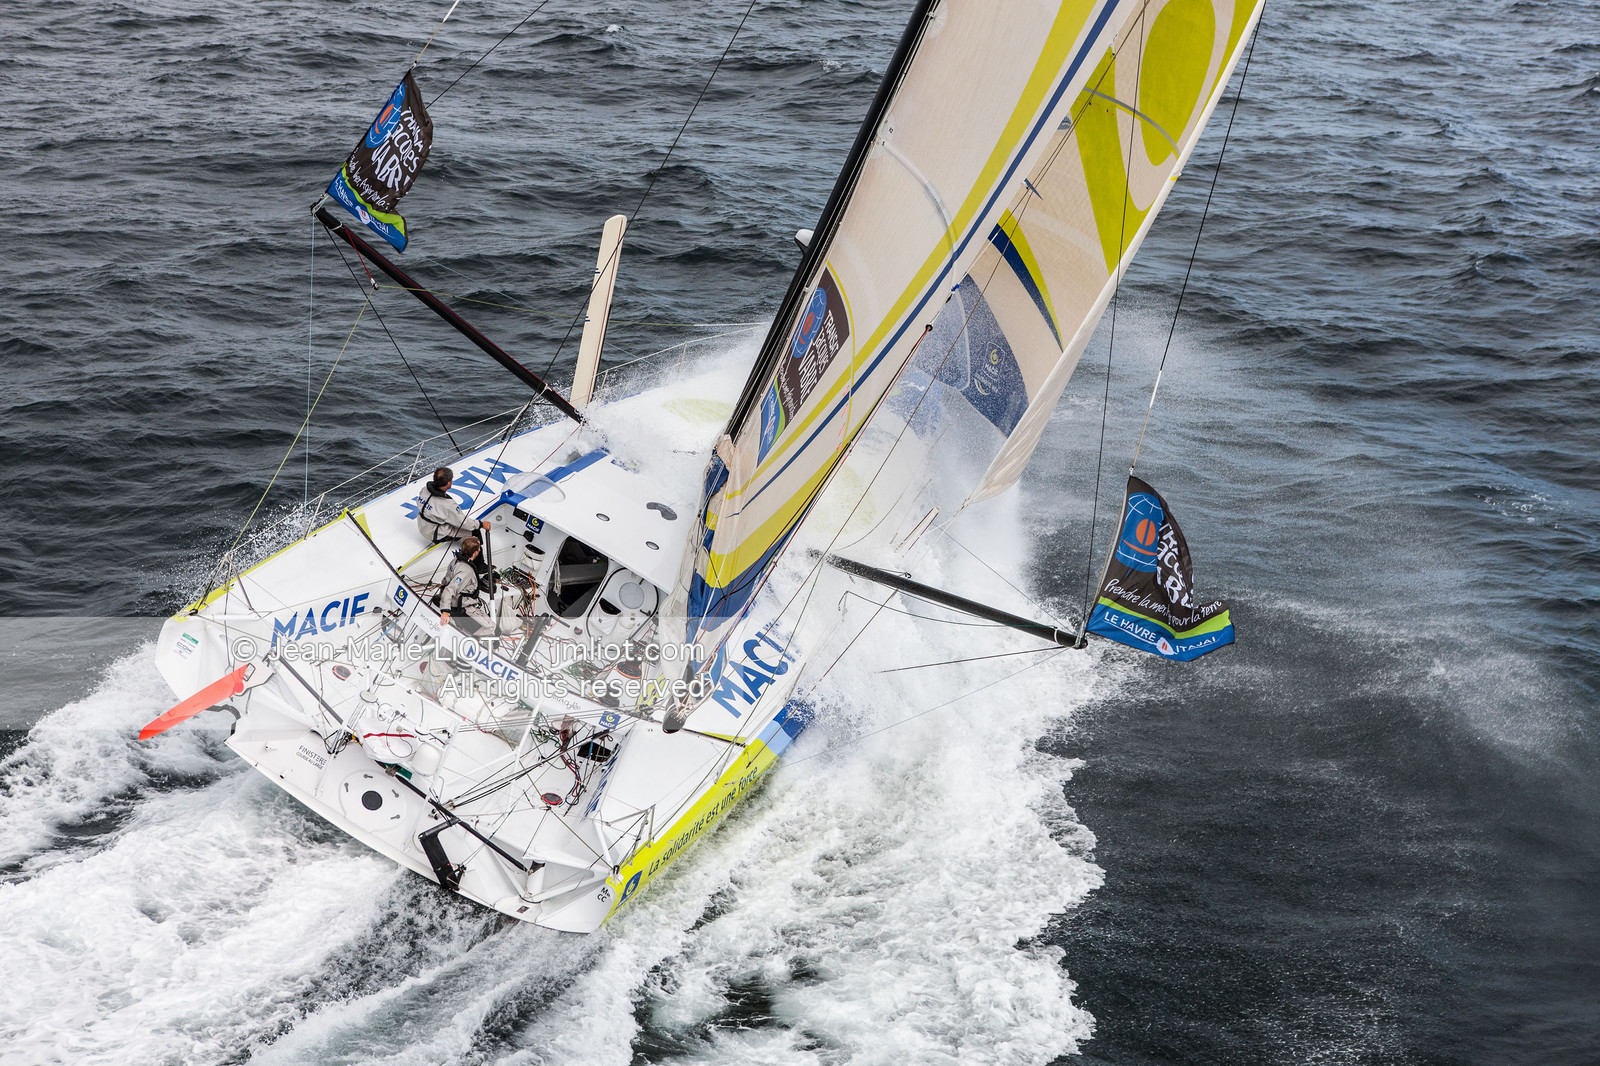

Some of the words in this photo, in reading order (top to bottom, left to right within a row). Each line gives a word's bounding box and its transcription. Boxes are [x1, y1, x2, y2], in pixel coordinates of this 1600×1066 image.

[418, 497, 433, 511] MAIF
[526, 523, 540, 532] MACIF
[270, 592, 370, 648] MACIF
[1104, 578, 1142, 604] Prendre
[1138, 593, 1149, 610] la
[1191, 609, 1201, 624] la
[1104, 611, 1119, 625] LE
[1119, 617, 1158, 642] HAVRE
[711, 618, 802, 718] MACI
[648, 860, 659, 877] La
[661, 813, 705, 866] solidarité
[706, 803, 720, 824] est
[721, 787, 737, 809] une
[737, 766, 758, 793] force
